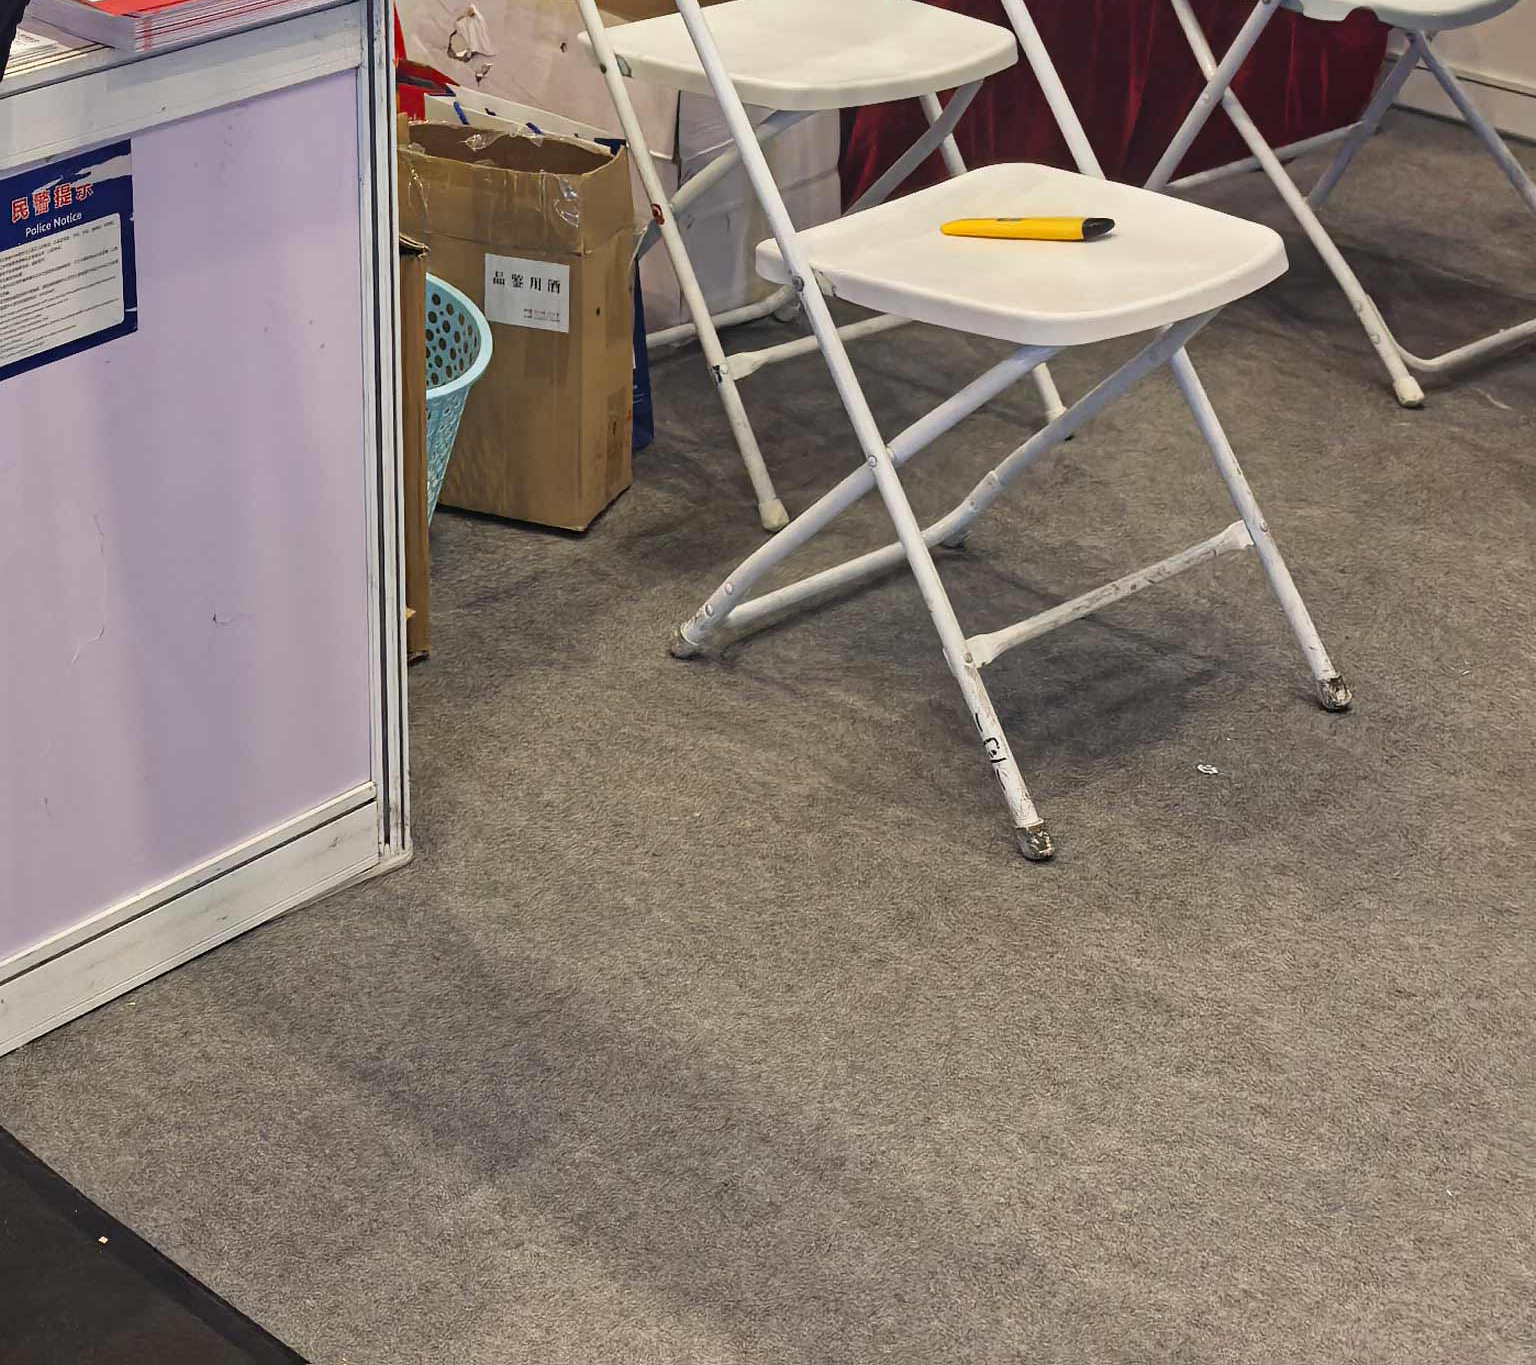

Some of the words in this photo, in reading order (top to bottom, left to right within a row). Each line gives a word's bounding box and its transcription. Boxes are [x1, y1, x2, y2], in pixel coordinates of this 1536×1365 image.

[10, 182, 94, 224] 民警提示
[25, 219, 52, 238] Police
[53, 212, 82, 229] Notice
